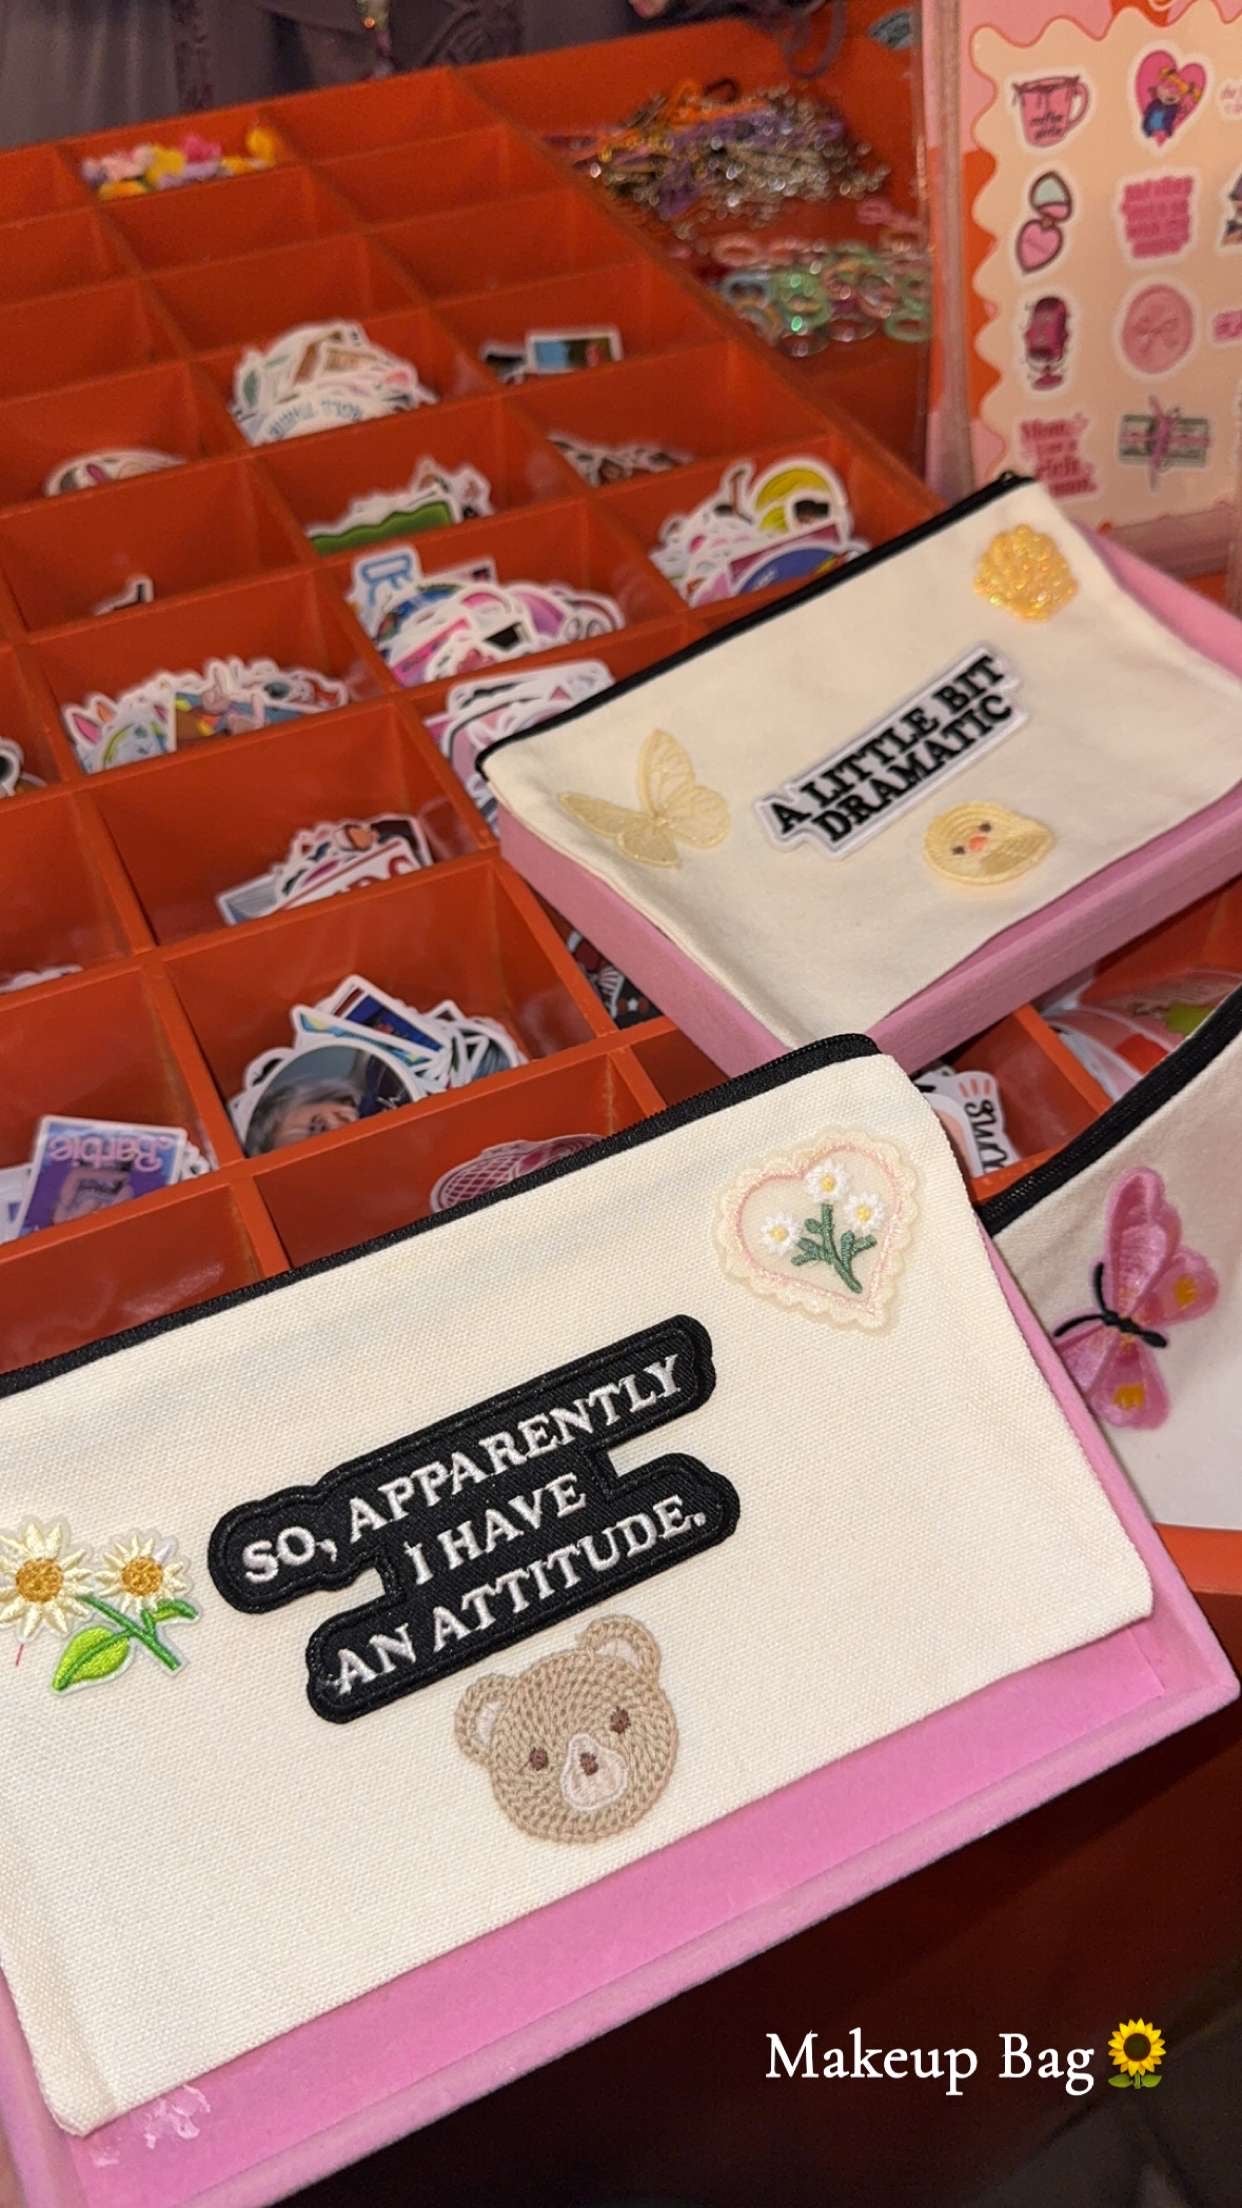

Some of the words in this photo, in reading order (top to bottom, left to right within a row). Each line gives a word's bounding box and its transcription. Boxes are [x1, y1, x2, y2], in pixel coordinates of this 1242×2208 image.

[770, 801, 811, 835] A
[801, 706, 941, 808] LITTLE
[932, 655, 1005, 714] BIT
[811, 694, 1013, 843] DRAMATIC
[49, 1134, 176, 1173] Barbie
[242, 1525, 338, 1585] SO,
[348, 1354, 682, 1543] APPARENTLY
[403, 1541, 433, 1586] I
[436, 1471, 588, 1570] HAVE
[330, 1623, 419, 1696] AN
[432, 1494, 707, 1652] ATTITUDE.
